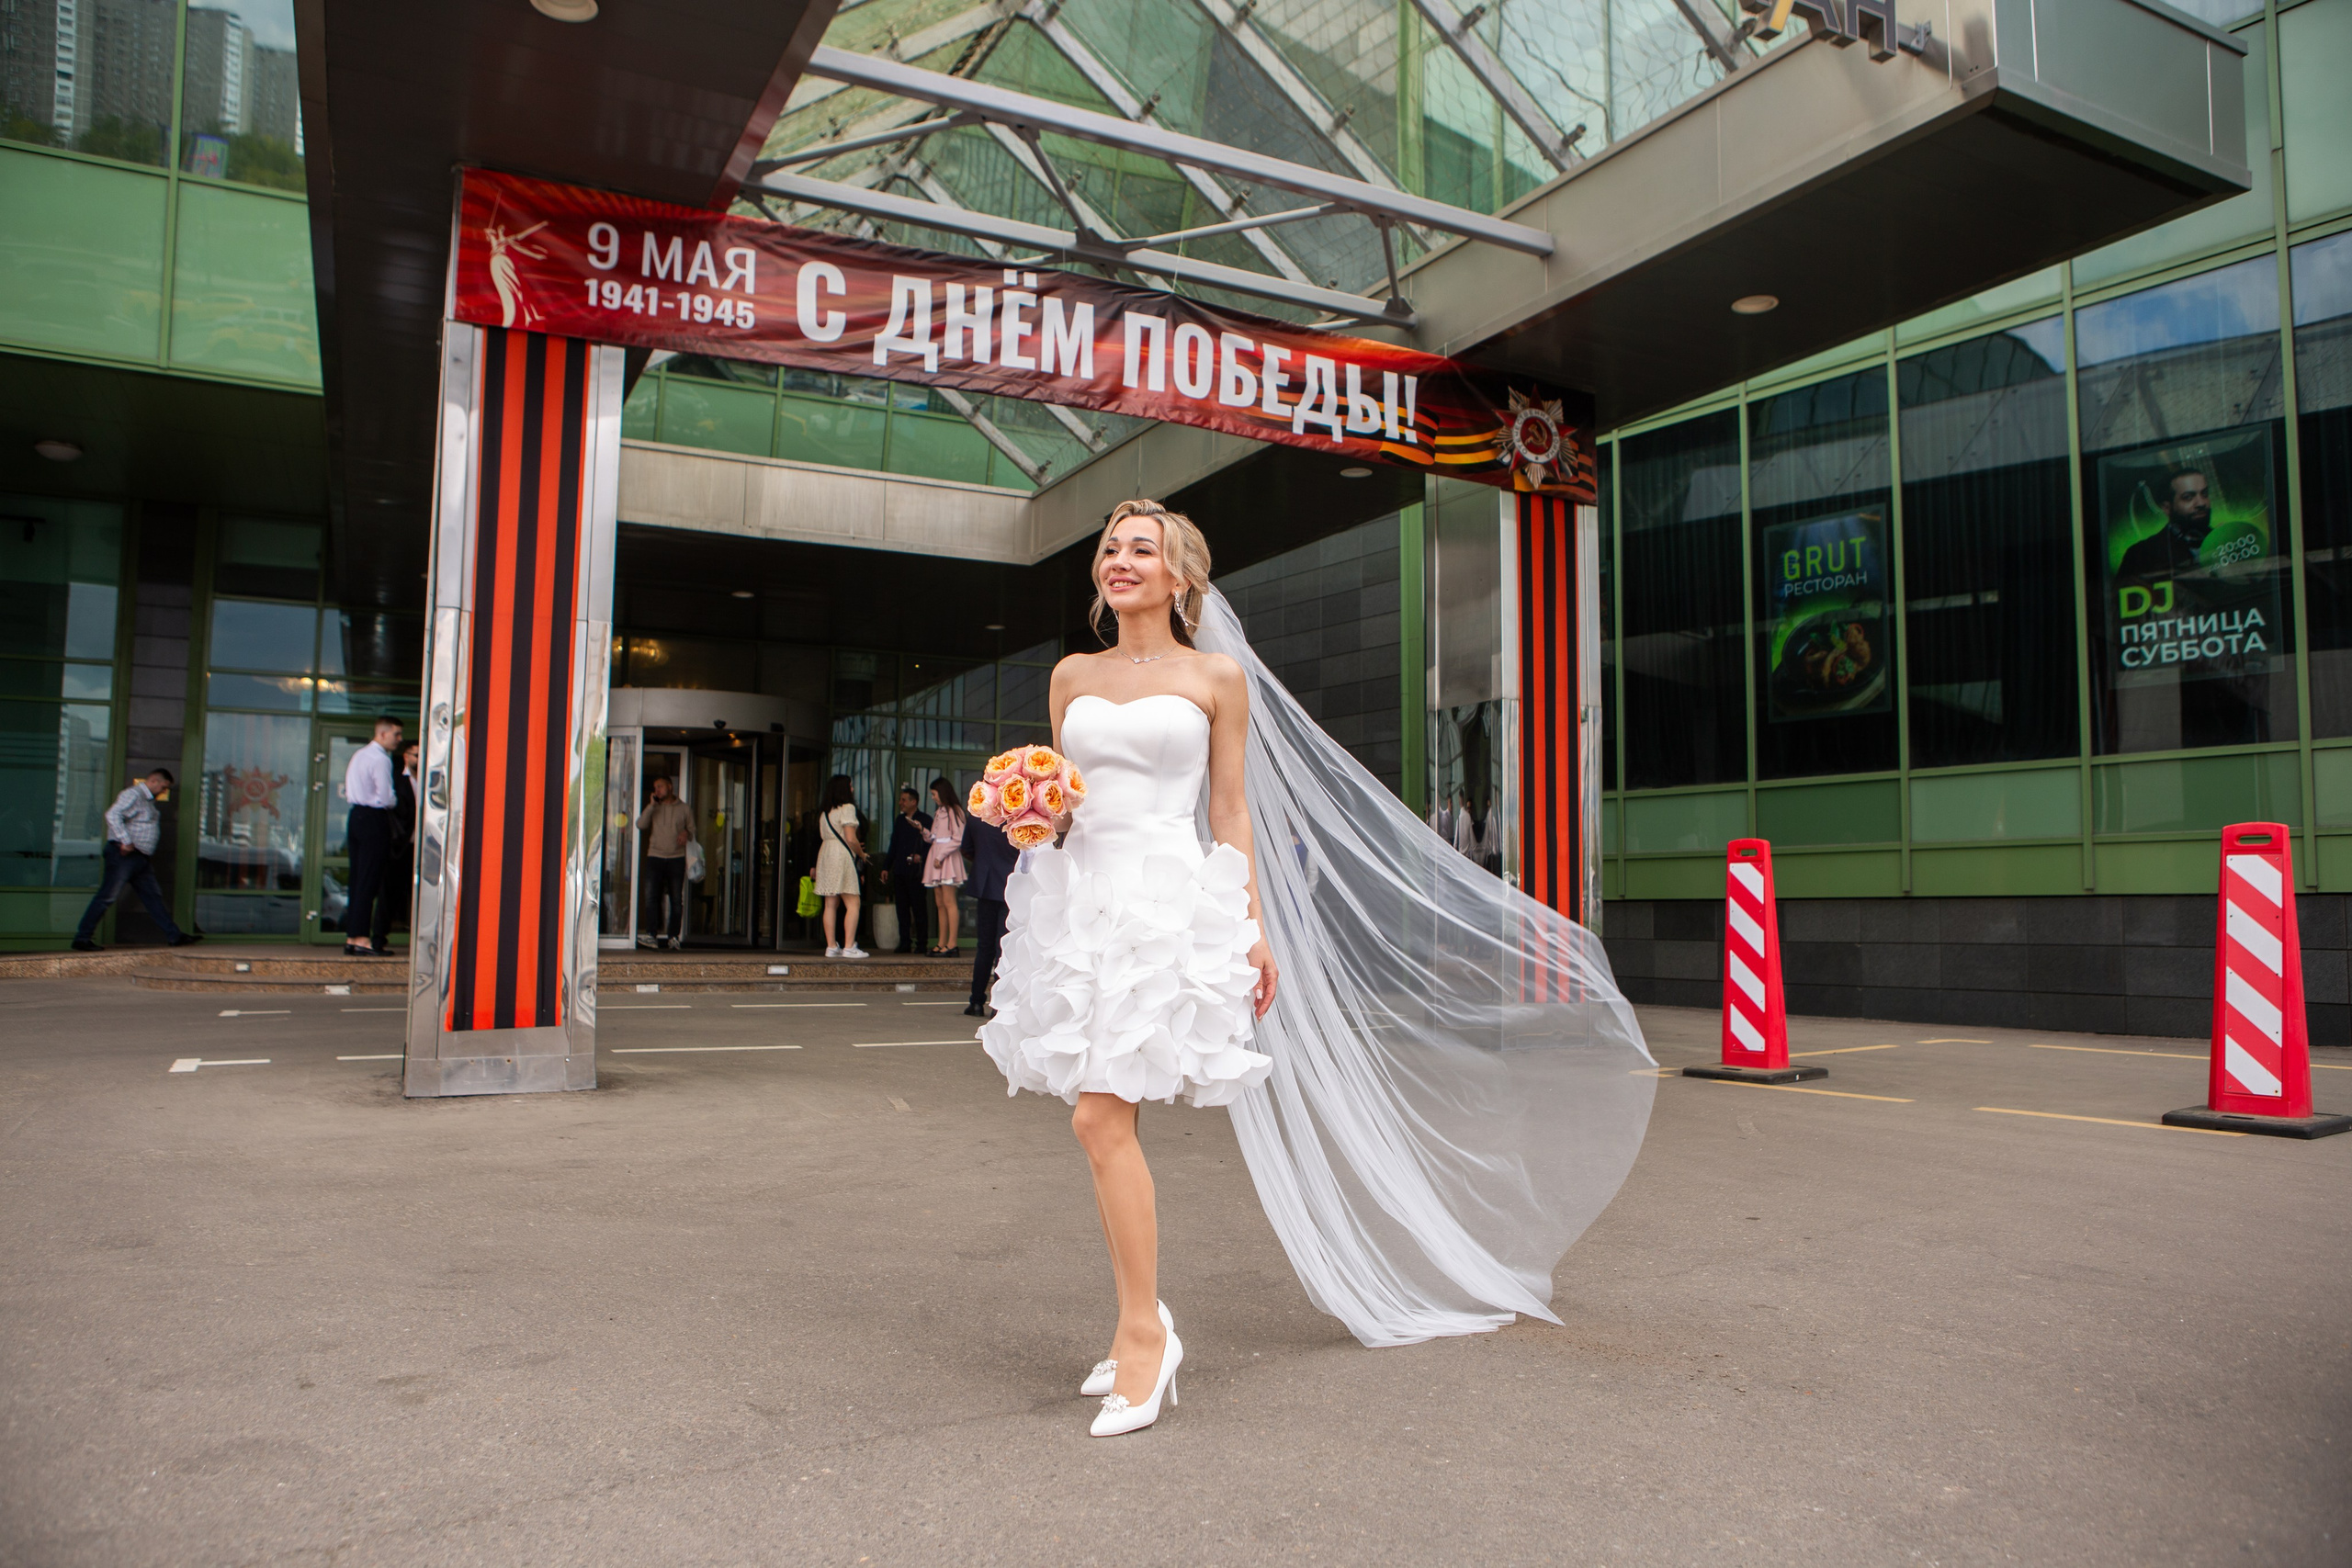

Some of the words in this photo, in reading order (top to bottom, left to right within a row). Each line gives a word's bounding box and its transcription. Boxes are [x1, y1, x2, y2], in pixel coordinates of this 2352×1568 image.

[587, 221, 620, 271] 9
[641, 231, 756, 296] МАЯ
[584, 277, 756, 331] 1941-1945
[796, 260, 847, 343] С
[873, 268, 1095, 380] ДНЁМ
[1122, 310, 1419, 445] ПОБЕДЫ!
[1782, 536, 1867, 581] GRUT
[2216, 534, 2256, 556] 20:00
[2221, 544, 2259, 567] 00:00
[1783, 570, 1868, 597] РЕСТОРАН
[2119, 581, 2175, 619] DJ
[2120, 607, 2266, 644] ПЯТНИЦА
[2120, 631, 2267, 669] СУББОТА
